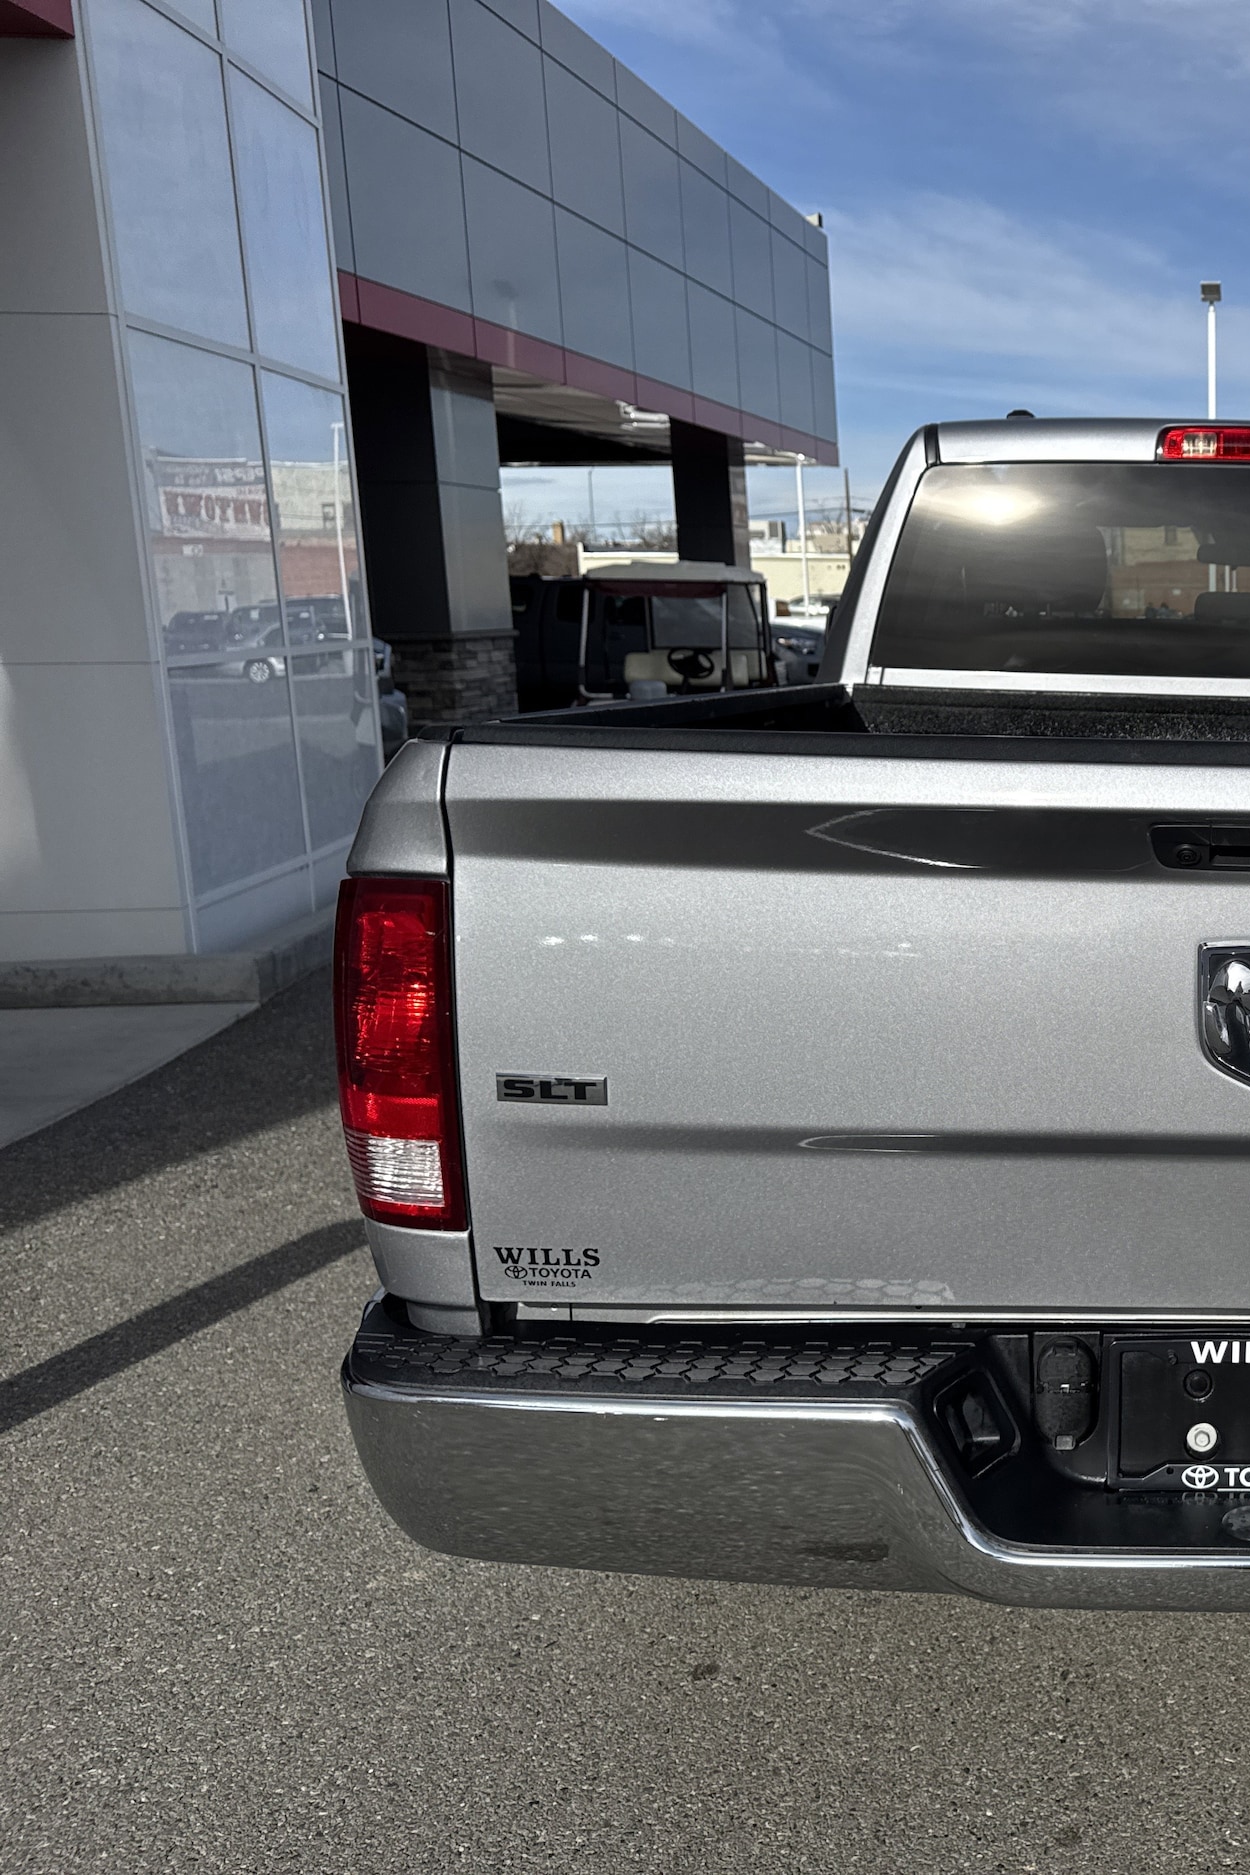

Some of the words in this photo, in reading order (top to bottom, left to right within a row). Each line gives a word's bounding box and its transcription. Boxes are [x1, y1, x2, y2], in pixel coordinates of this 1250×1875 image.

[503, 1078, 597, 1100] SLT
[493, 1247, 600, 1267] WILLS
[528, 1267, 592, 1279] TOYOTA
